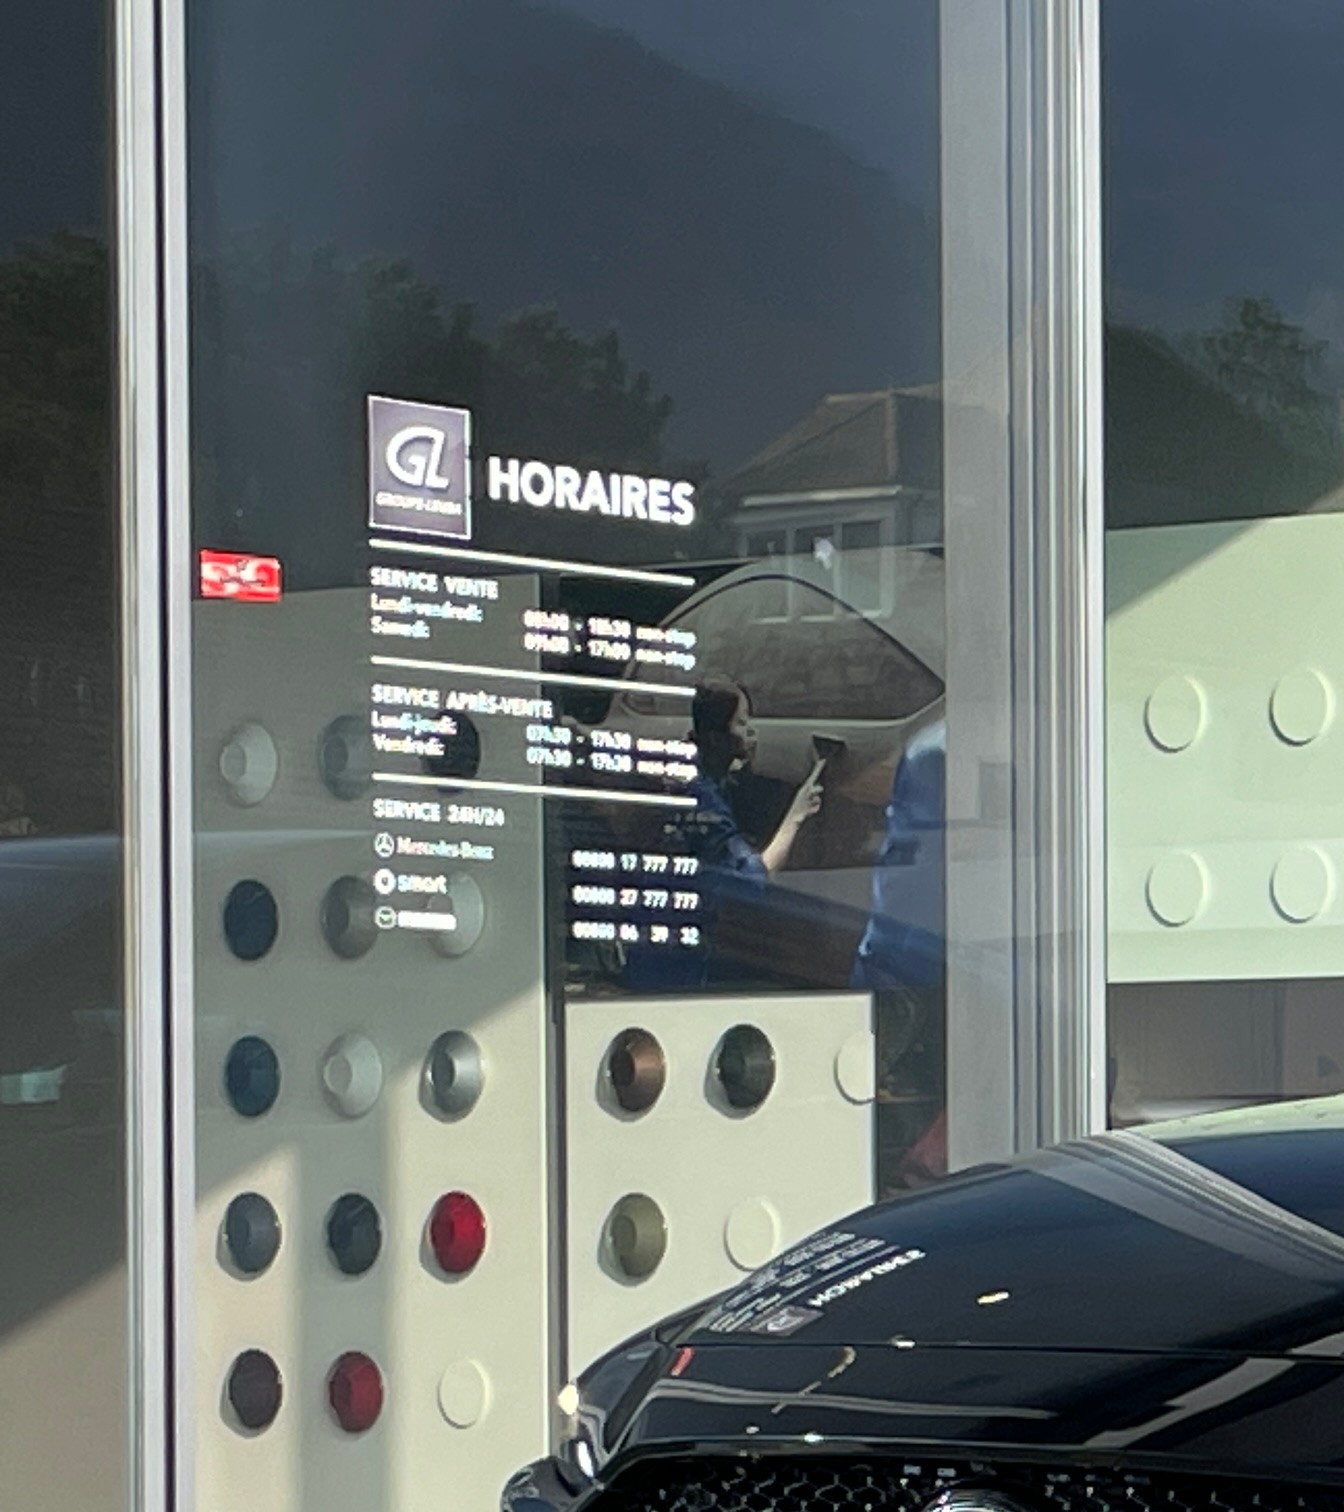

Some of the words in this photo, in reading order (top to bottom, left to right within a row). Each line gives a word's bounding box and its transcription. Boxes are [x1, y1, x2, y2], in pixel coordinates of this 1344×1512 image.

[385, 426, 449, 489] GL
[486, 456, 695, 526] HORAIRES
[370, 566, 438, 592] SERVICE
[443, 576, 498, 599] VENTE
[371, 683, 440, 709] SERVICE
[446, 690, 553, 718] APRÈS-VENTE
[373, 798, 440, 823] SERVICE
[448, 804, 505, 826] 24H/24
